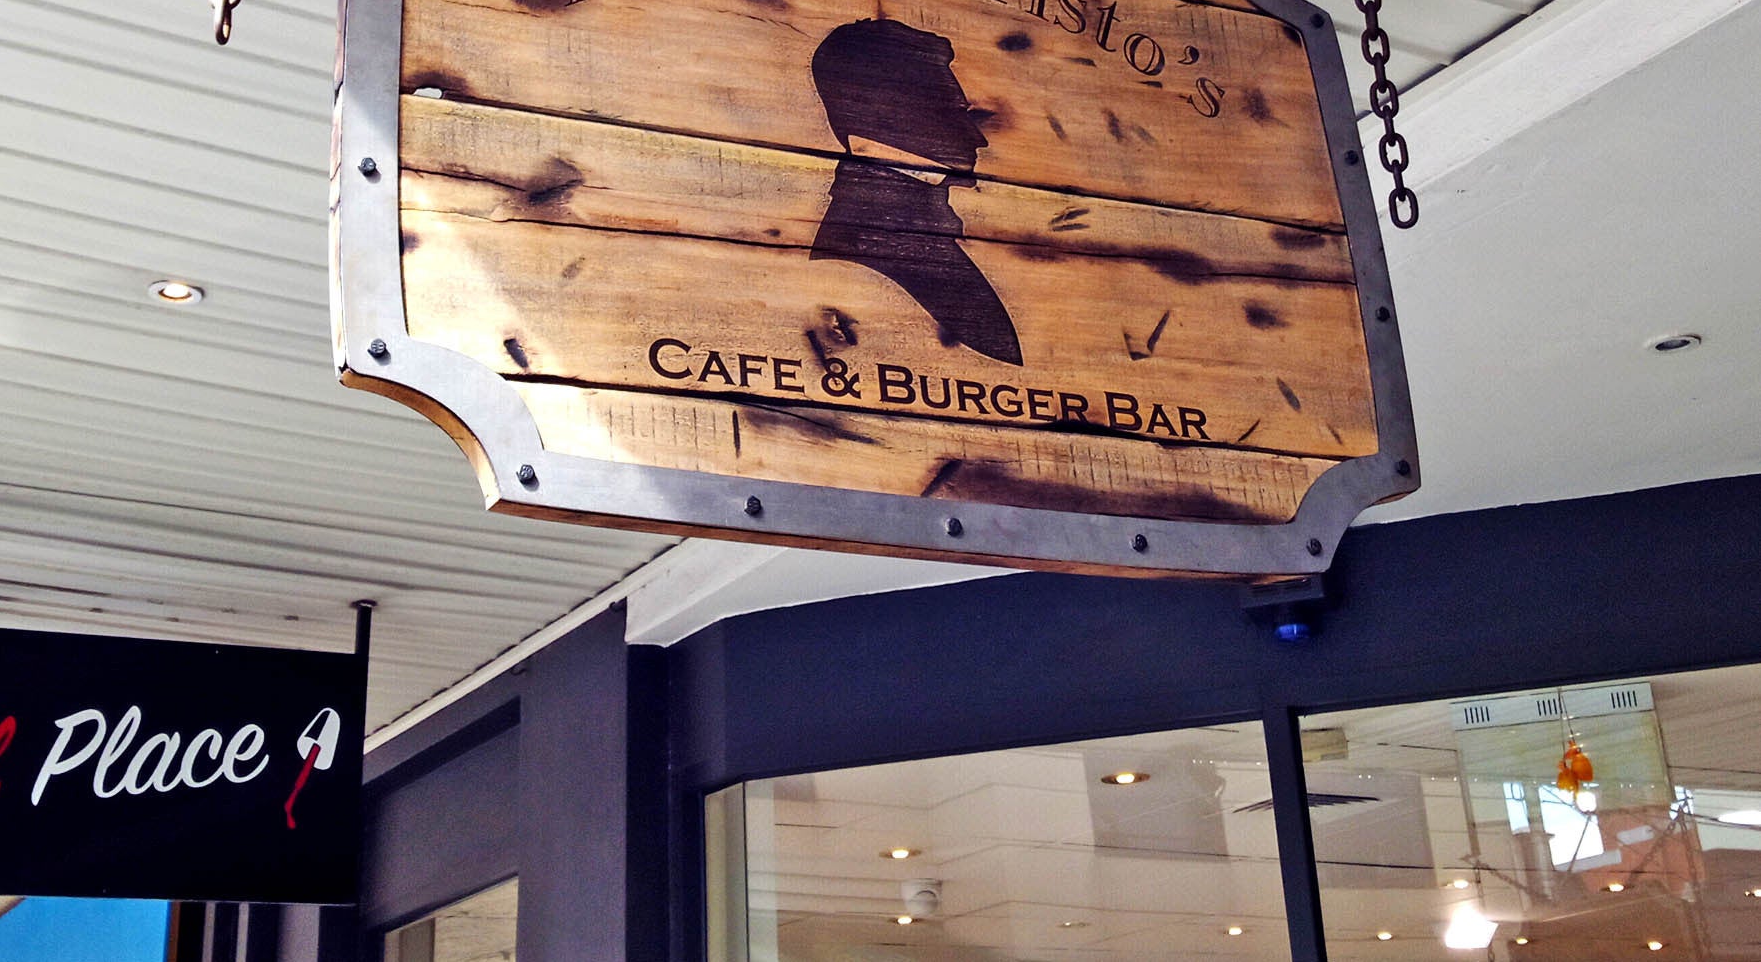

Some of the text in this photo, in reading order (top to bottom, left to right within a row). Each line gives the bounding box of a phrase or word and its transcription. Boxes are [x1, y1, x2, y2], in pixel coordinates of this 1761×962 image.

[648, 337, 1212, 440] CAFE & BURGER BAR
[31, 705, 270, 807] Place
